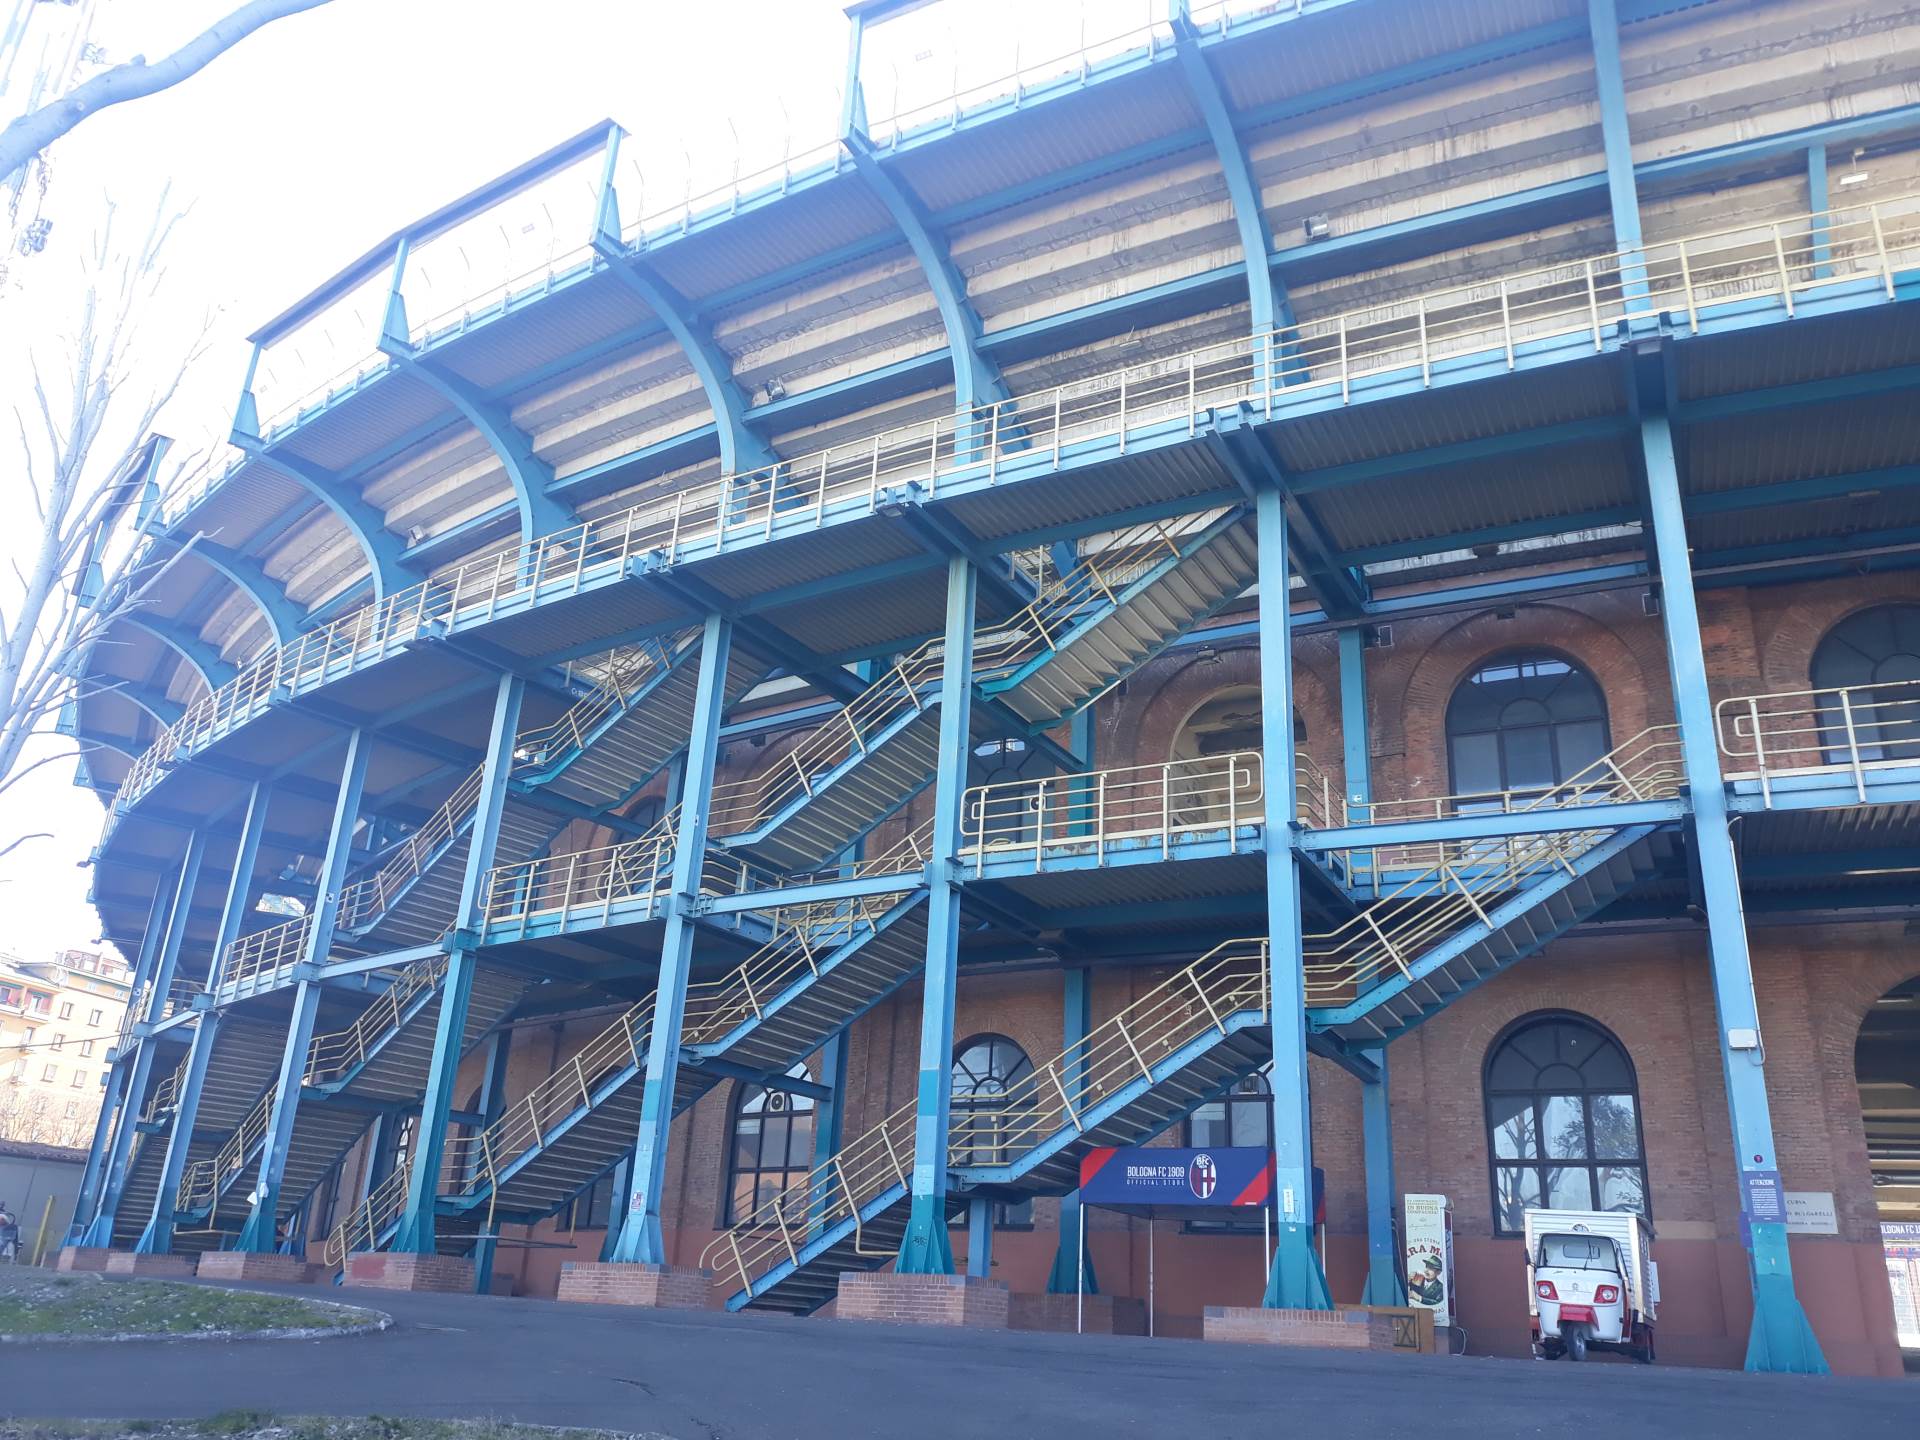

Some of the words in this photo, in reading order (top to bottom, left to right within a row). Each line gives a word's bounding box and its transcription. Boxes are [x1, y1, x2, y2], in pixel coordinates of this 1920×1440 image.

[1127, 1166, 1157, 1177] BOLOGNA
[1158, 1166, 1167, 1177] FC
[1167, 1166, 1185, 1178] 1909
[1407, 1244, 1427, 1258] RA
